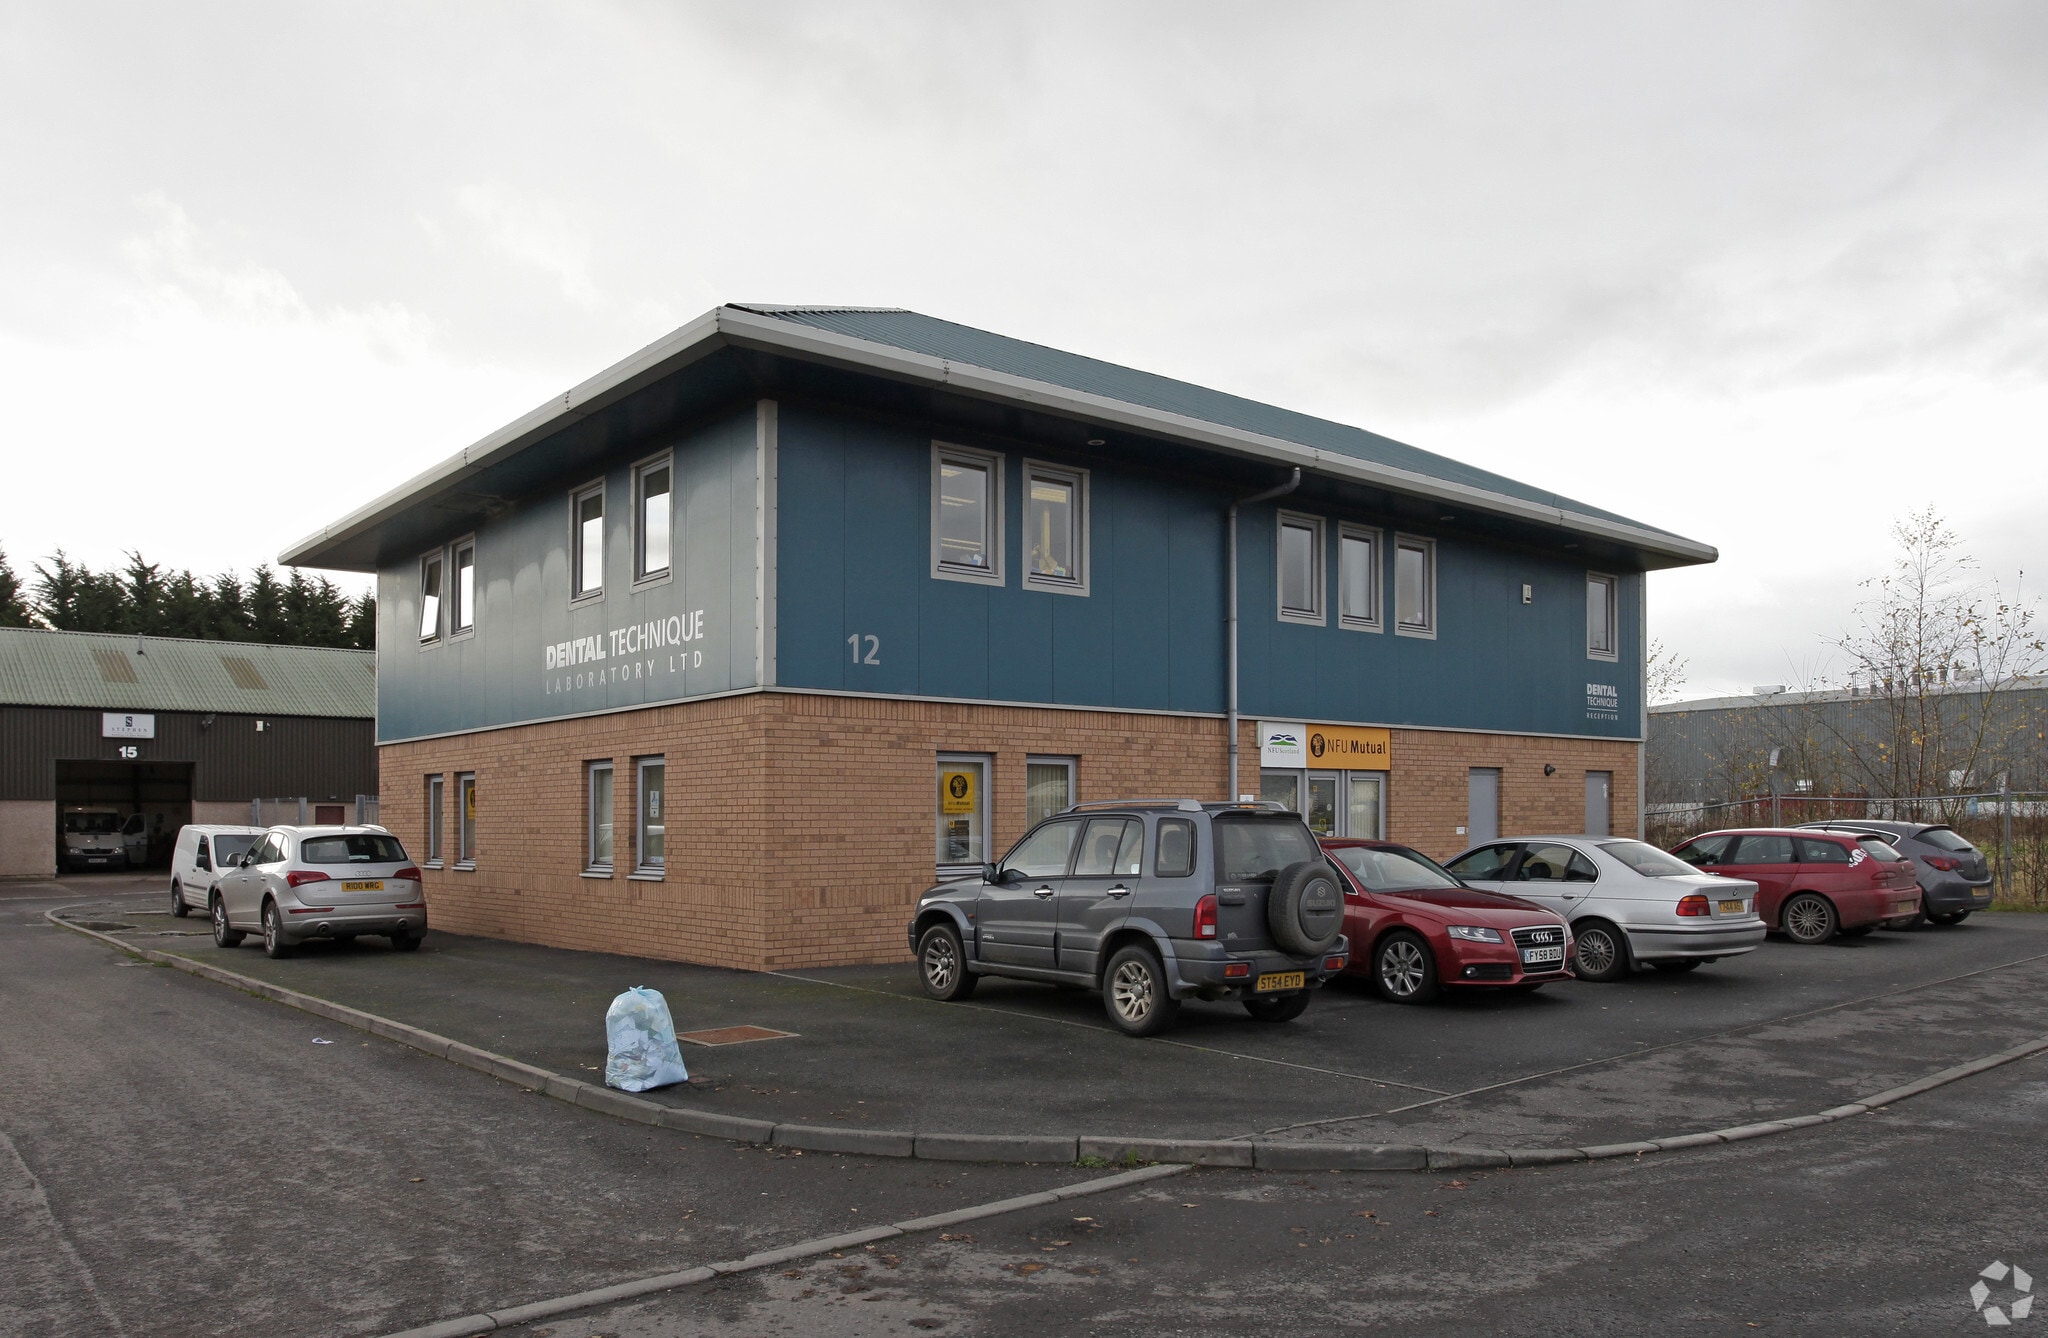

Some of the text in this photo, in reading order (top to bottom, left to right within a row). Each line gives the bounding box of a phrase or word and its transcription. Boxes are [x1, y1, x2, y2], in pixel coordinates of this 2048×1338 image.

[546, 609, 704, 670] DENTAL TECHNIQUE
[847, 633, 881, 665] 12
[546, 650, 702, 695] LABORATORY LTD
[1586, 683, 1618, 697] DENTAL
[1586, 696, 1618, 708] TECHNIQUE
[1586, 712, 1618, 720] RECEPTION
[118, 746, 138, 759] 15
[1327, 739, 1387, 754] NFU Mutual
[1306, 899, 1335, 907] SUZUKI
[1529, 950, 1548, 961] FY58
[1260, 974, 1301, 989] ST54 EYD
